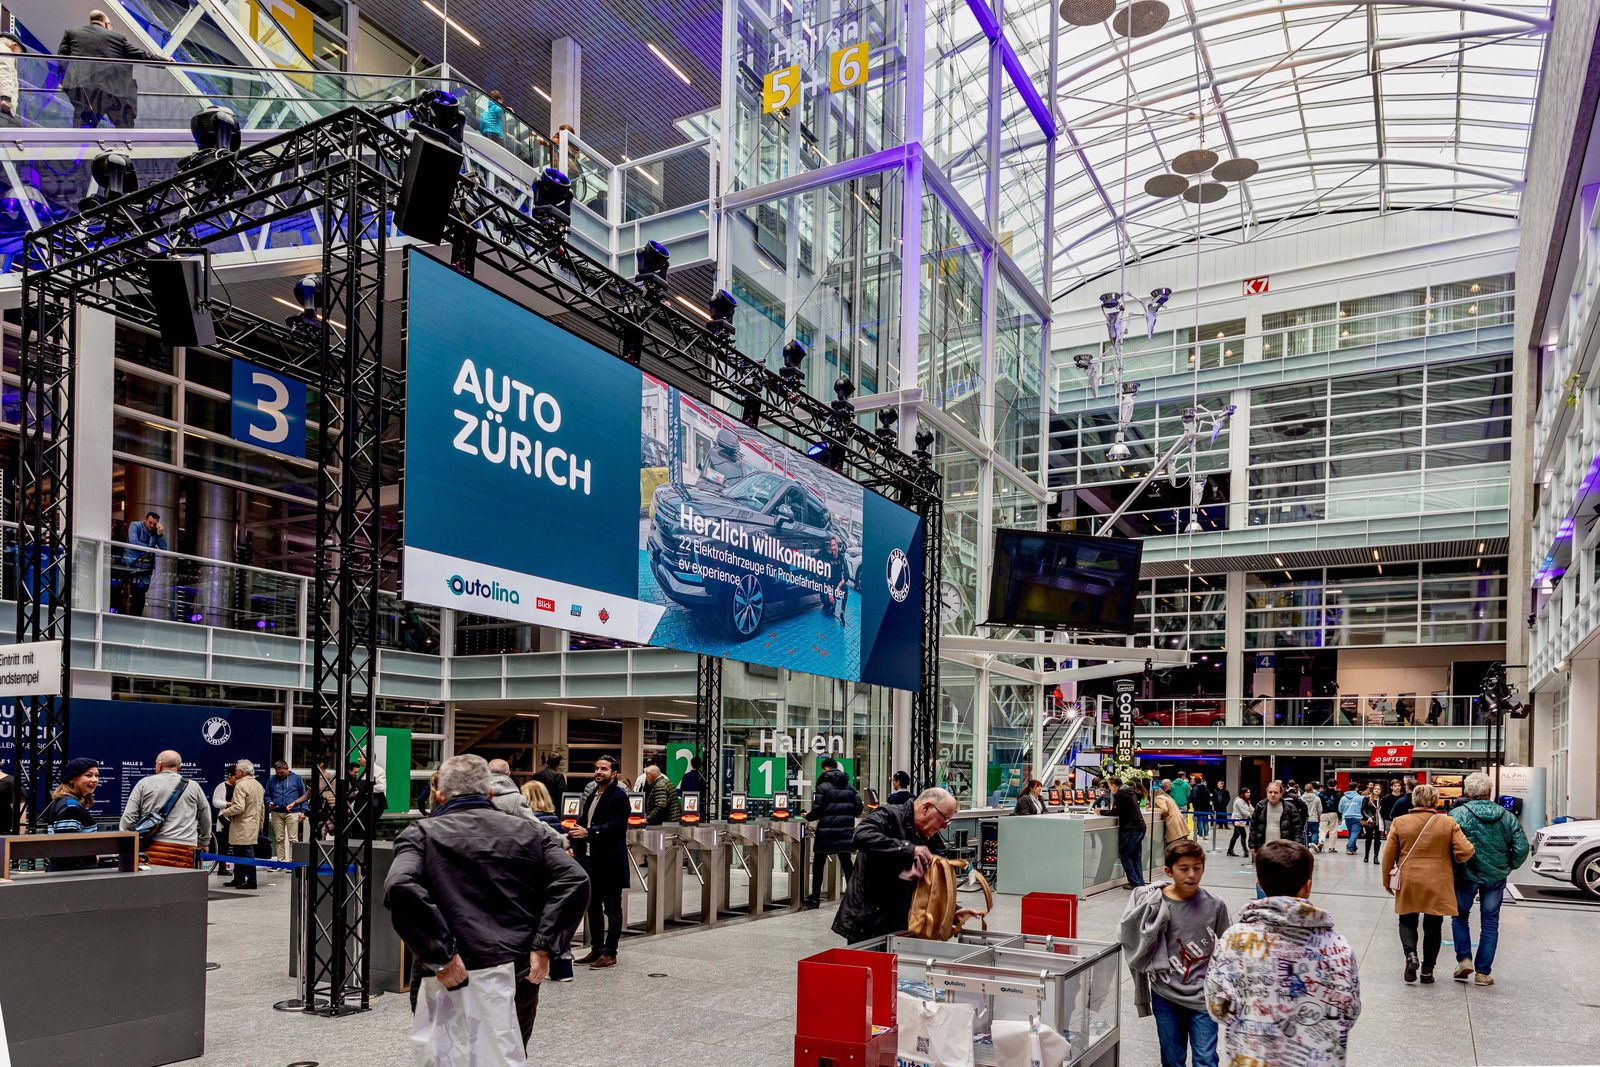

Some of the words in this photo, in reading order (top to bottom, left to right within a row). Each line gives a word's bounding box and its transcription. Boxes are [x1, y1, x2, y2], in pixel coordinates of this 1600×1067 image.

[774, 20, 859, 67] Hallen
[771, 70, 792, 109] 5
[838, 47, 861, 86] 6
[1243, 277, 1269, 295] K7
[249, 372, 289, 443] 3
[453, 359, 562, 433] AUTO
[453, 409, 591, 495] ZÜRICH
[681, 503, 749, 550] Herzlich
[752, 536, 832, 579] willkommen
[890, 550, 908, 568] AUTO
[678, 535, 692, 551] 22
[693, 539, 765, 576] Elektrofahrzeuge
[766, 564, 777, 578] für
[778, 567, 823, 592] Probefahrten
[824, 582, 834, 596] bei
[835, 587, 846, 600] der
[678, 558, 691, 571] ev
[692, 561, 741, 586] experience
[537, 599, 552, 610] Blick
[22, 651, 34, 665] mit
[1260, 656, 1270, 667] 4
[760, 728, 844, 754] Hallen
[1119, 693, 1132, 748] COFFEE
[757, 760, 773, 795] 1
